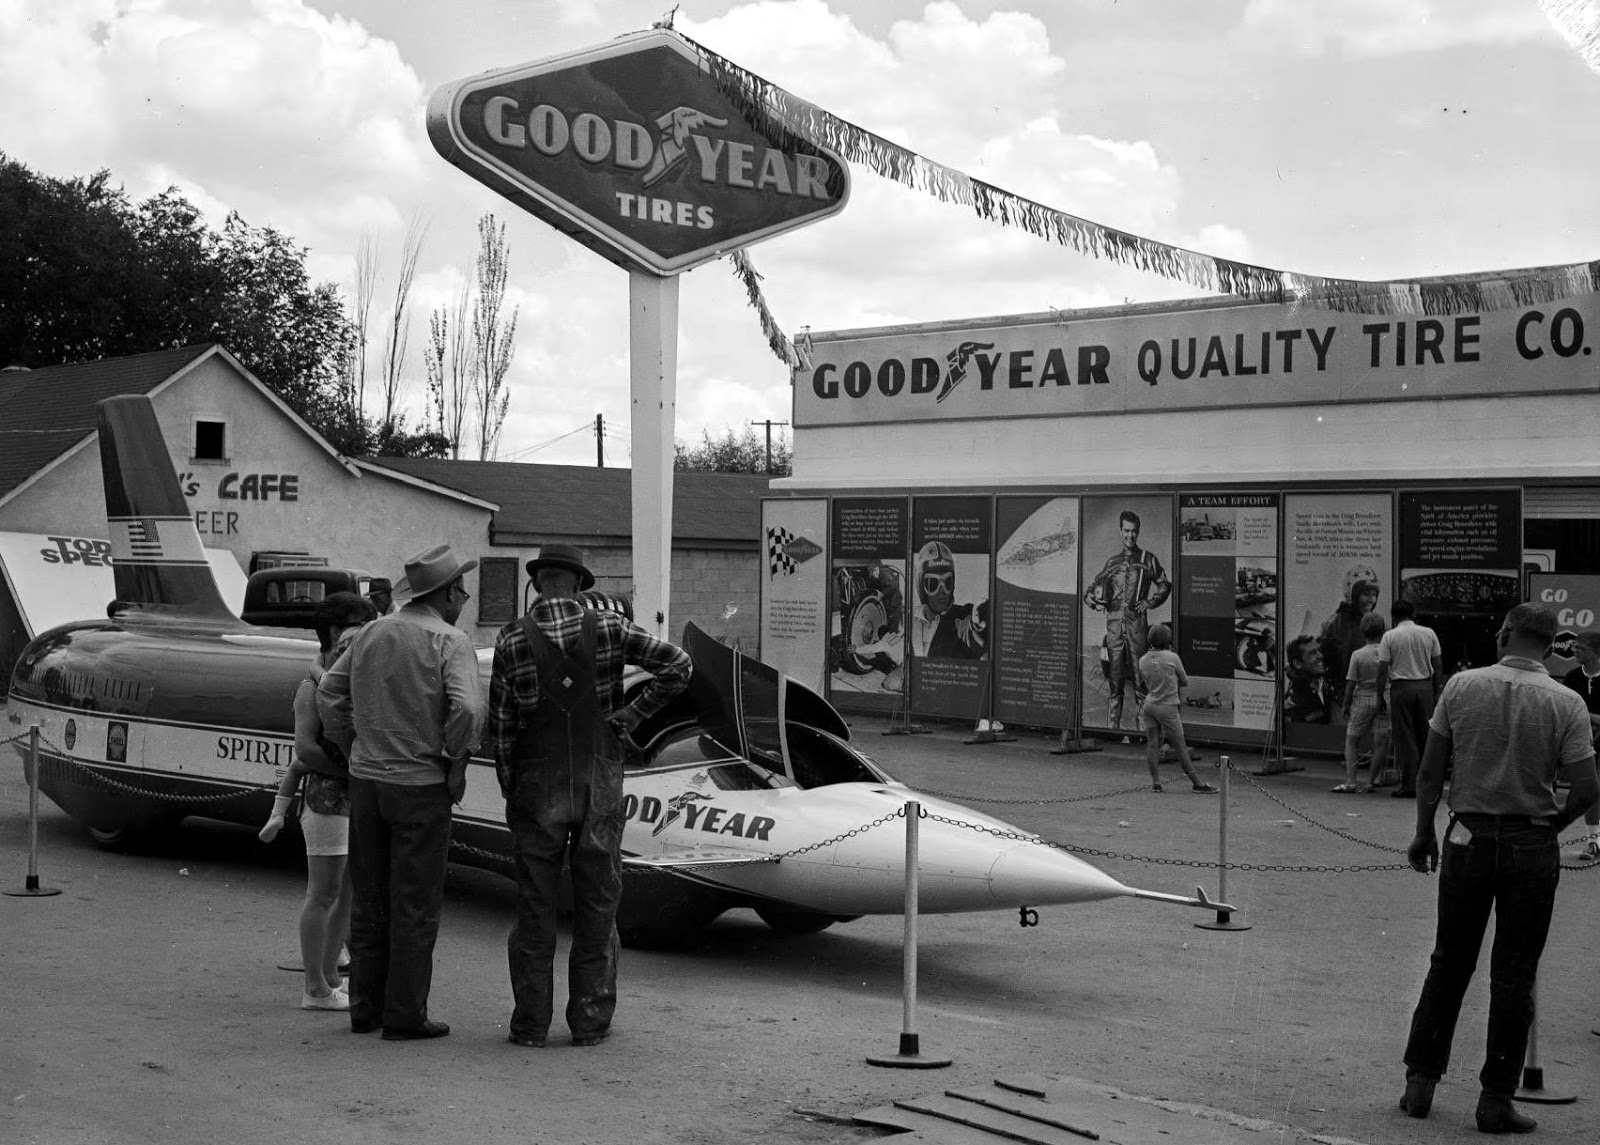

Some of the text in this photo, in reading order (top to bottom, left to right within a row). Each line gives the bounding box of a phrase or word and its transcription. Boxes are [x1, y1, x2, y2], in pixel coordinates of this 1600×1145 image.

[615, 191, 714, 229] TIRES
[1137, 326, 1336, 386] QUALITY
[1362, 316, 1480, 368] TIRE
[1515, 307, 1592, 360] CO.
[218, 473, 298, 501] CAFE
[1198, 497, 1227, 505] TEAM
[1231, 496, 1271, 505] EFFORT
[195, 510, 239, 534] EER
[1541, 588, 1568, 603] GO
[1557, 608, 1594, 627] GO
[217, 736, 295, 767] SPIRIT
[621, 794, 661, 823] OD
